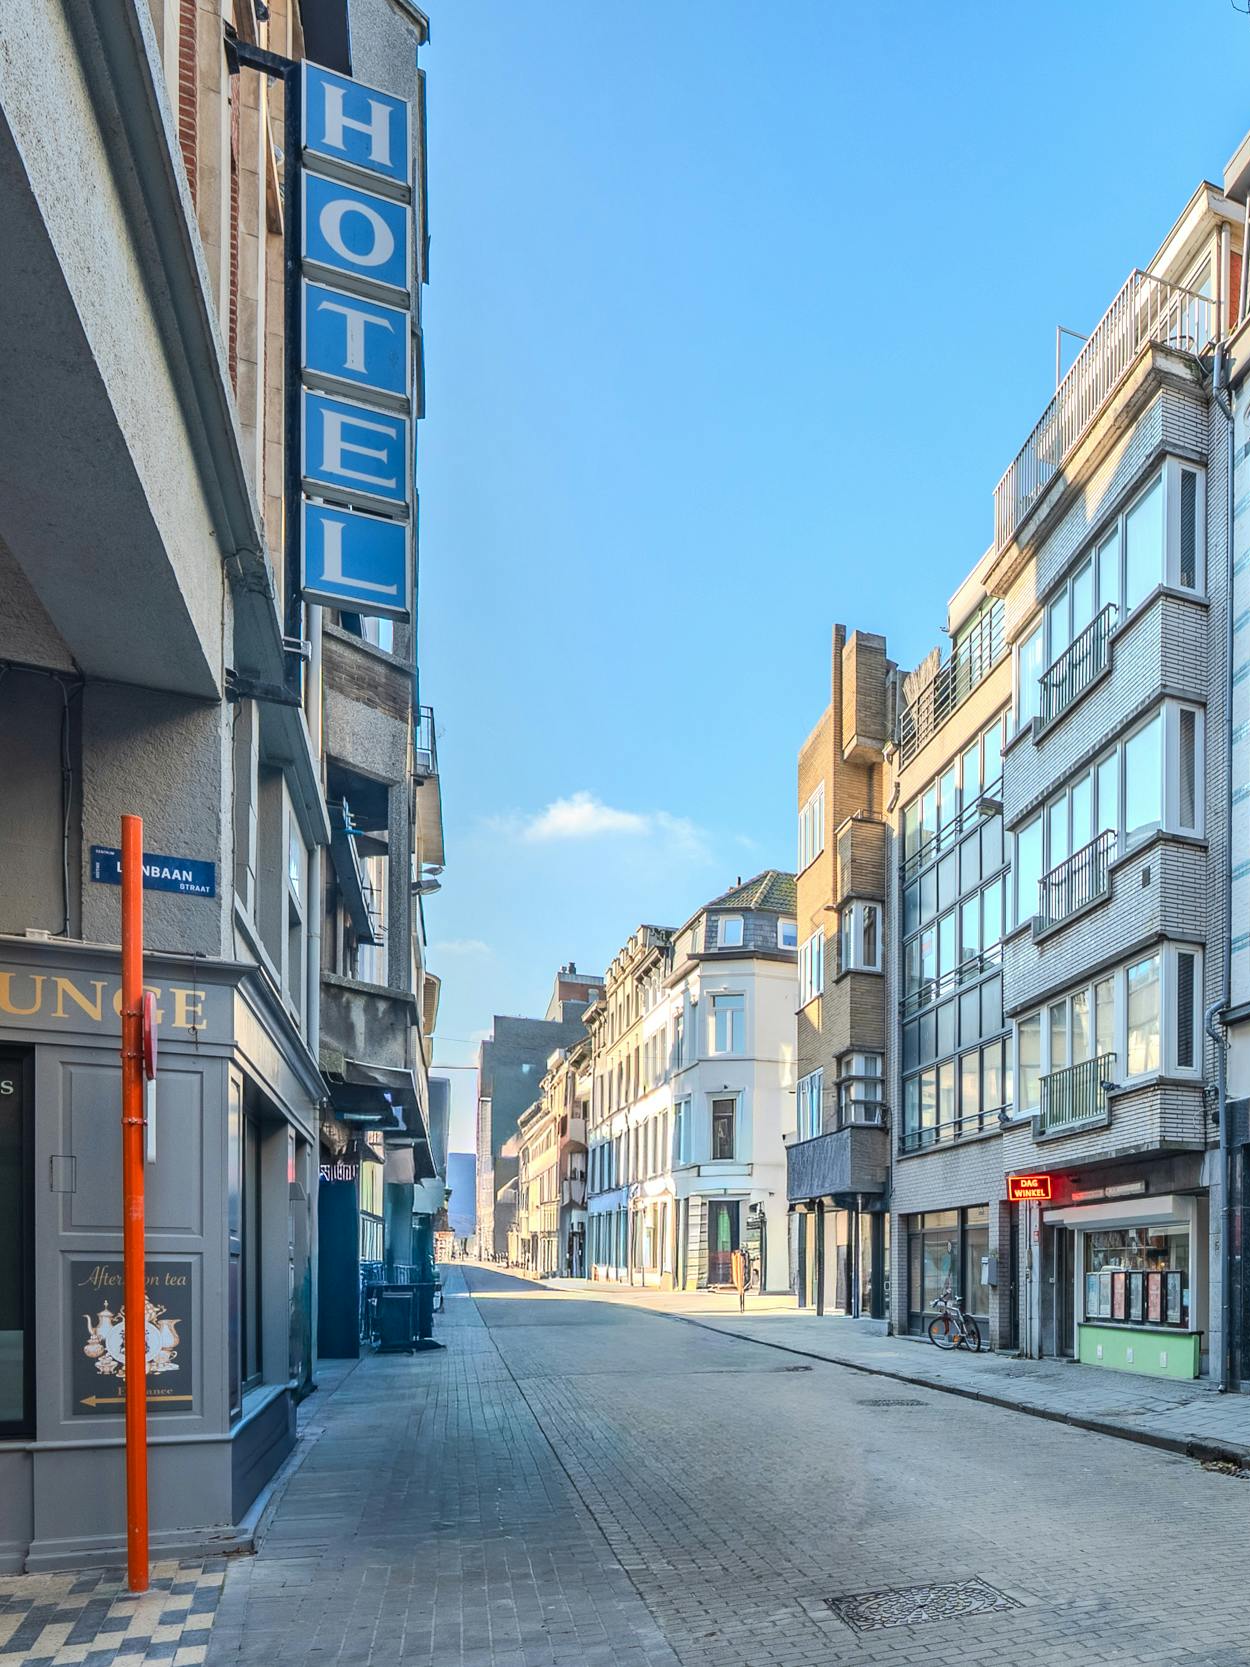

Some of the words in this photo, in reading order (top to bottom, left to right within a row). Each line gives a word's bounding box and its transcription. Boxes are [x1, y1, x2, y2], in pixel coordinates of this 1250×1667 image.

[316, 80, 397, 596] HOTEL
[116, 861, 193, 882] LNBAAN
[179, 884, 210, 893] STRAAT
[1014, 1189, 1046, 1198] WINKEL
[77, 1264, 159, 1291] Aftern
[165, 1272, 186, 1286] tea
[117, 1387, 173, 1396] Eance
